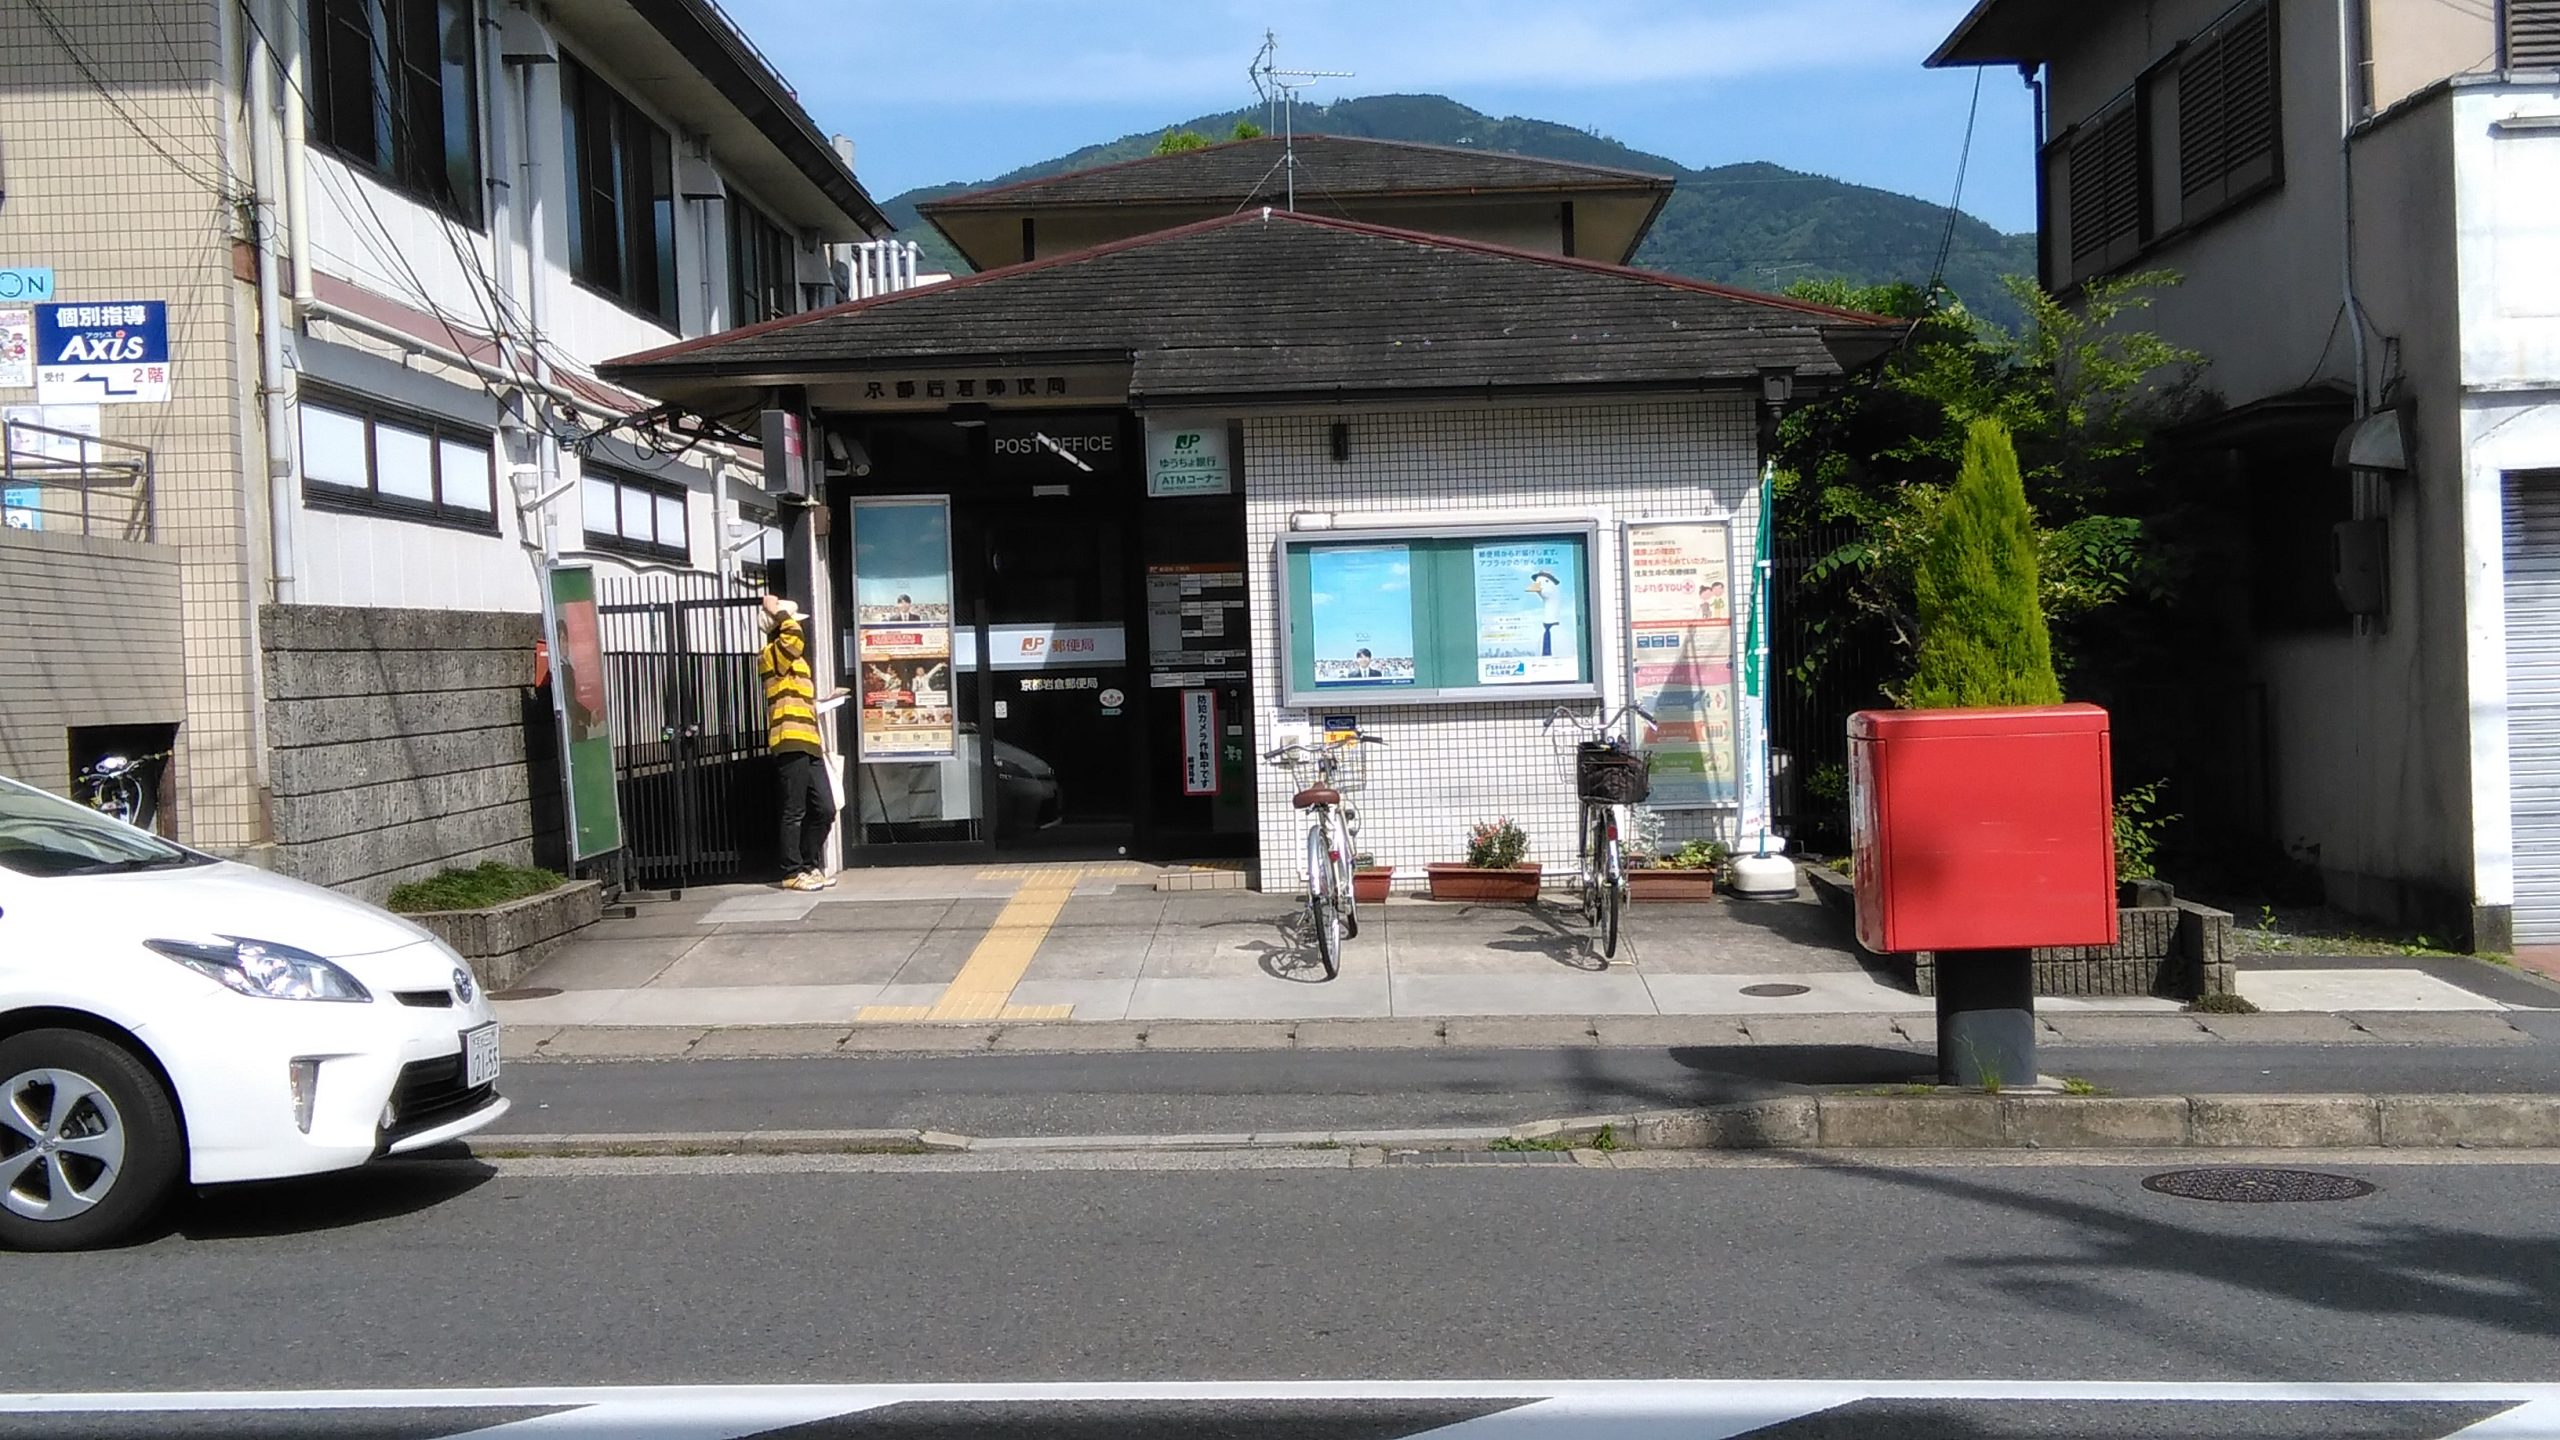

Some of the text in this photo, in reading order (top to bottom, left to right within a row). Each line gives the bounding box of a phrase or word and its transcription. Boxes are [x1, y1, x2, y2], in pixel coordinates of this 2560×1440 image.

[56, 305, 146, 328] 個別指導
[85, 331, 113, 339] アクシス
[44, 372, 65, 383] 受付
[994, 435, 1113, 454] POST OFFICE
[1159, 456, 1217, 469] ゆうちょ銀行
[1161, 475, 1223, 486] ATMコーナー
[1051, 638, 1095, 653] 郵便局
[1020, 677, 1099, 692] 京都岩倉郵便局
[1197, 694, 1210, 789] 防犯カメラ作動中です
